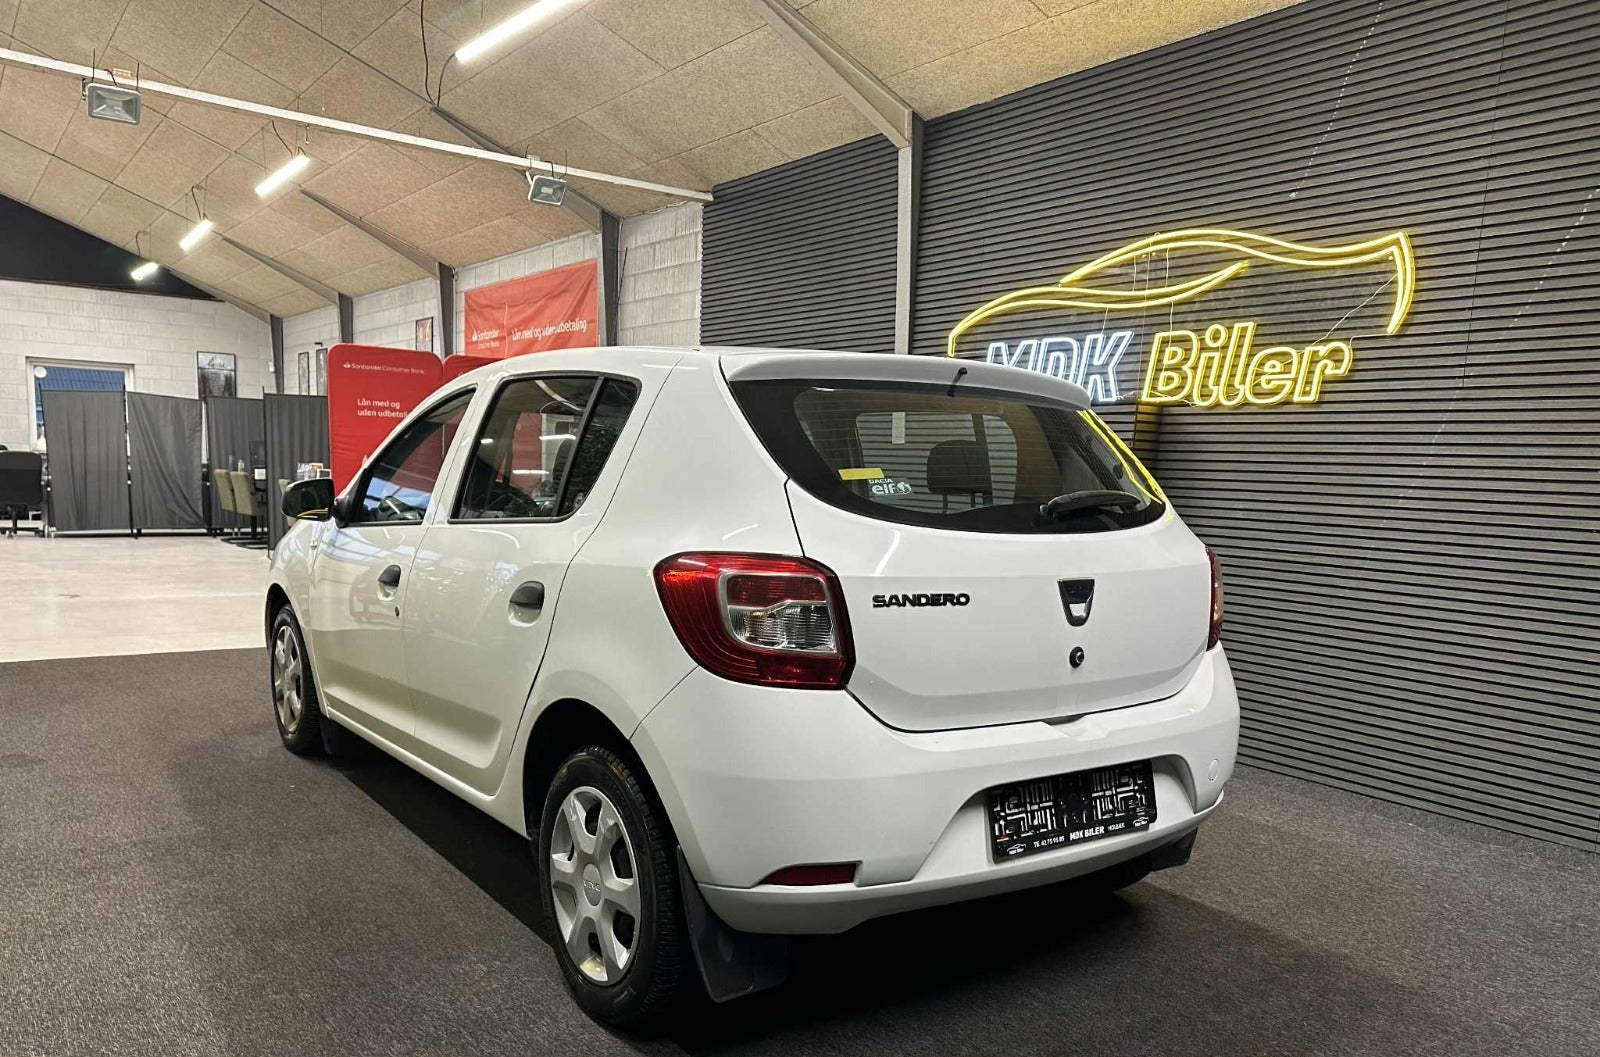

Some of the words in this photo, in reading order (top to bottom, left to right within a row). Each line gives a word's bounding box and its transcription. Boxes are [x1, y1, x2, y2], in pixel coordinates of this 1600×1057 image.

[1139, 321, 1353, 407] Biler
[357, 398, 371, 406] Lån
[372, 400, 390, 408] med
[390, 402, 400, 410] og
[357, 409, 377, 417] uden
[378, 410, 409, 418] udbetali
[871, 483, 896, 495] elf
[872, 593, 970, 608] SANDERO
[1084, 826, 1105, 839] BILER
